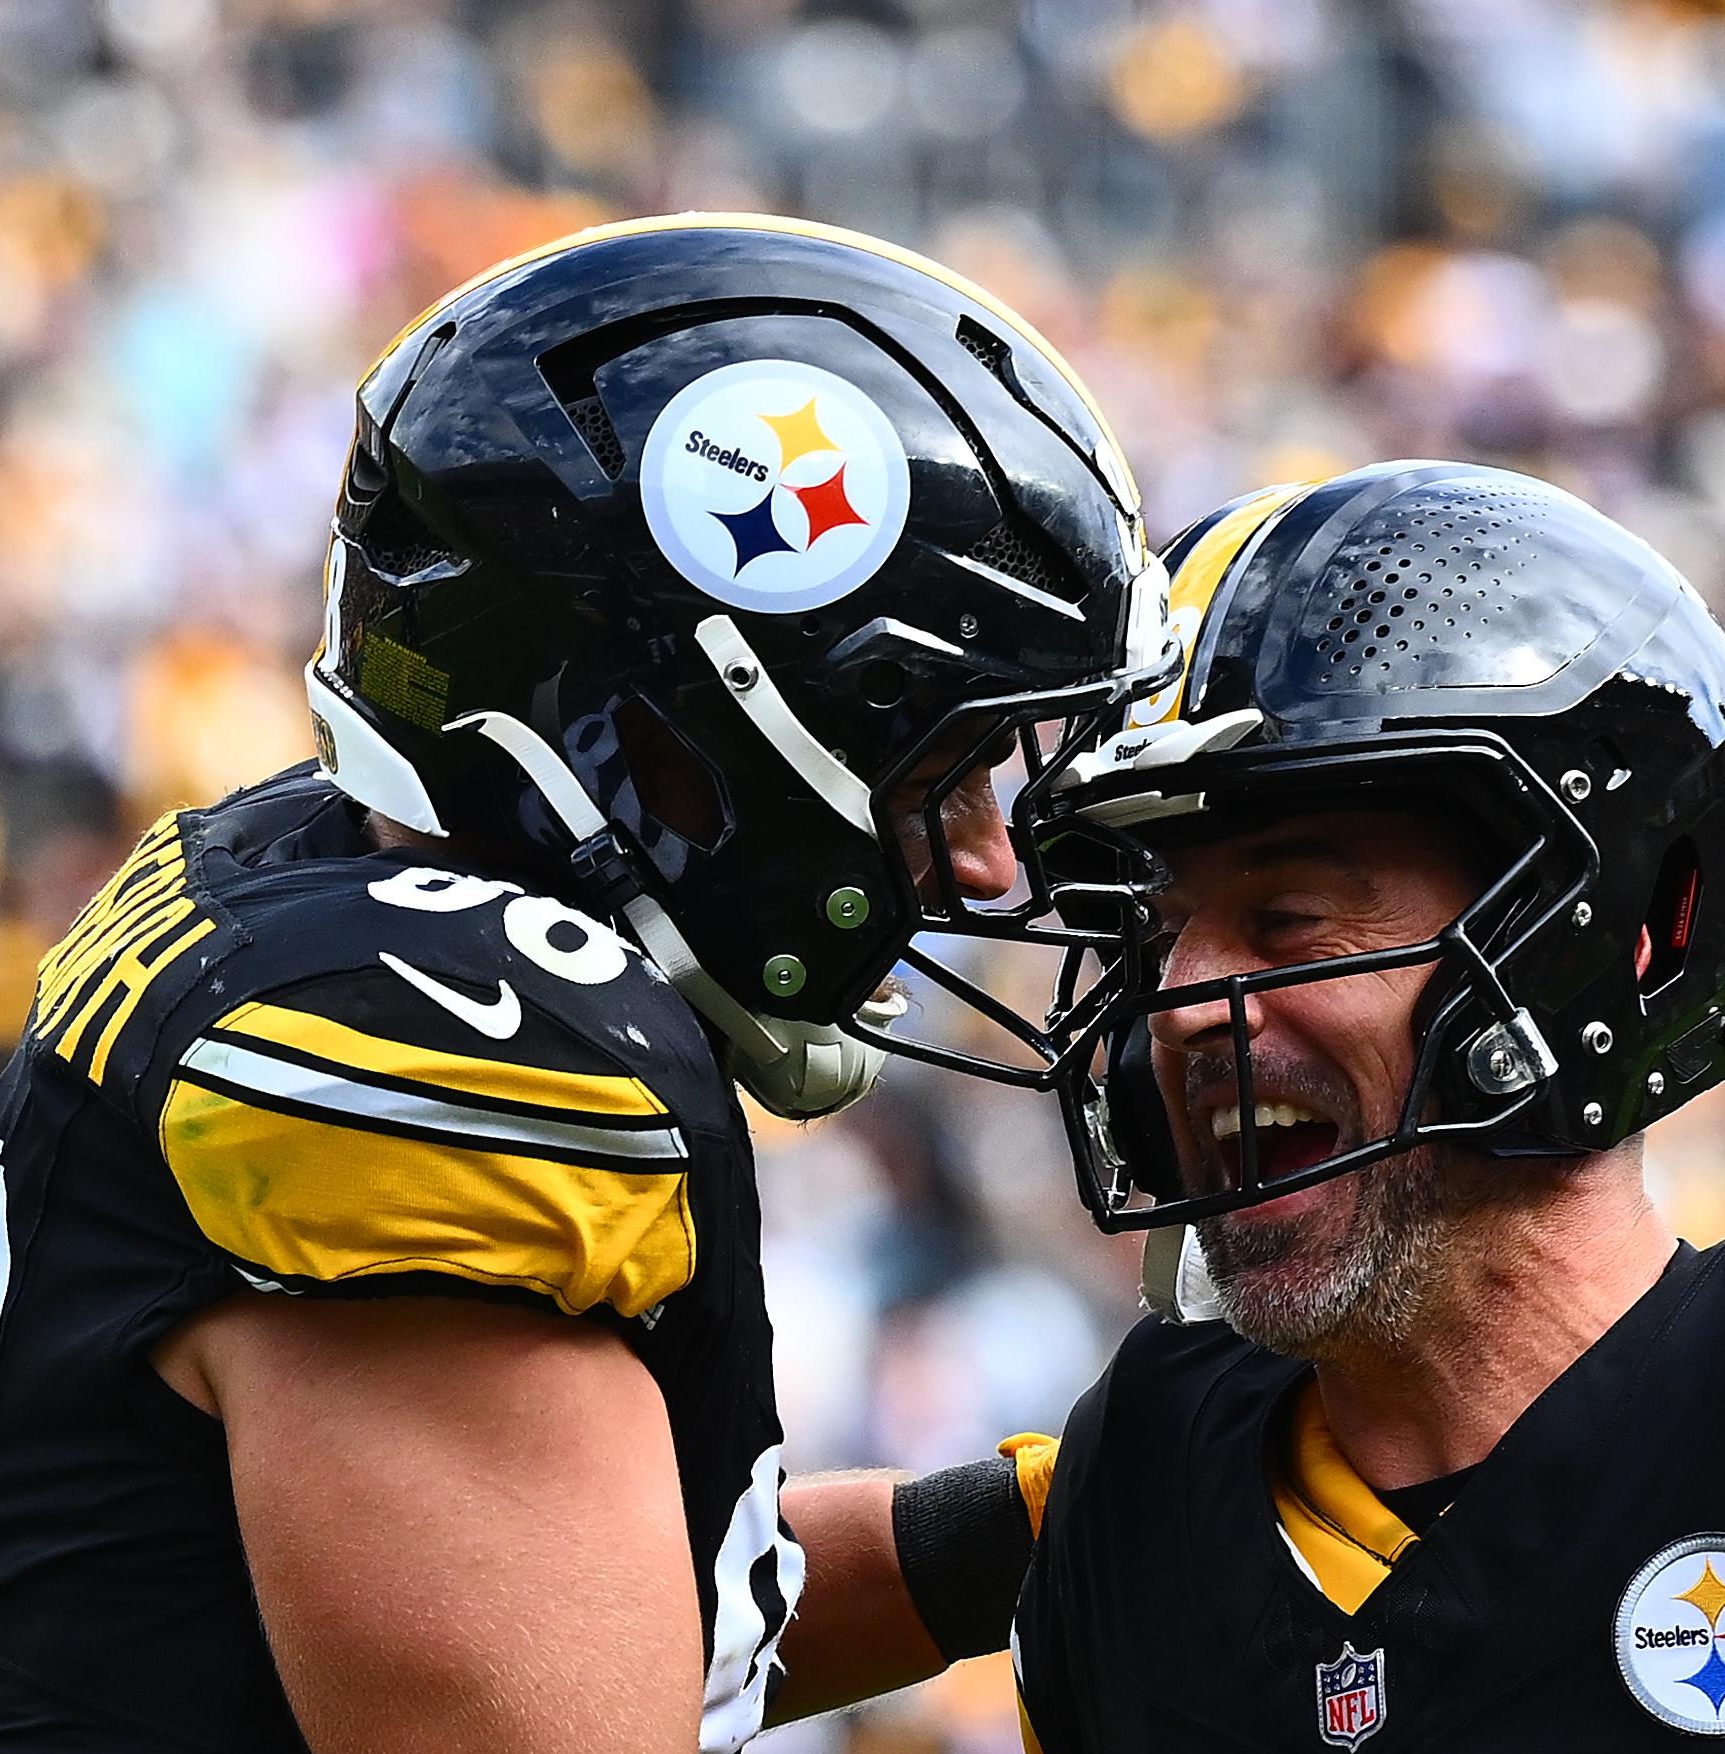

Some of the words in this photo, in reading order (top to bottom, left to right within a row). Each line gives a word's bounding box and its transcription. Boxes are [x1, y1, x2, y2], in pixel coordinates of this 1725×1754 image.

[685, 430, 769, 482] Steelers
[1635, 1625, 1709, 1649] Steelers
[1327, 1690, 1375, 1734] NFL
